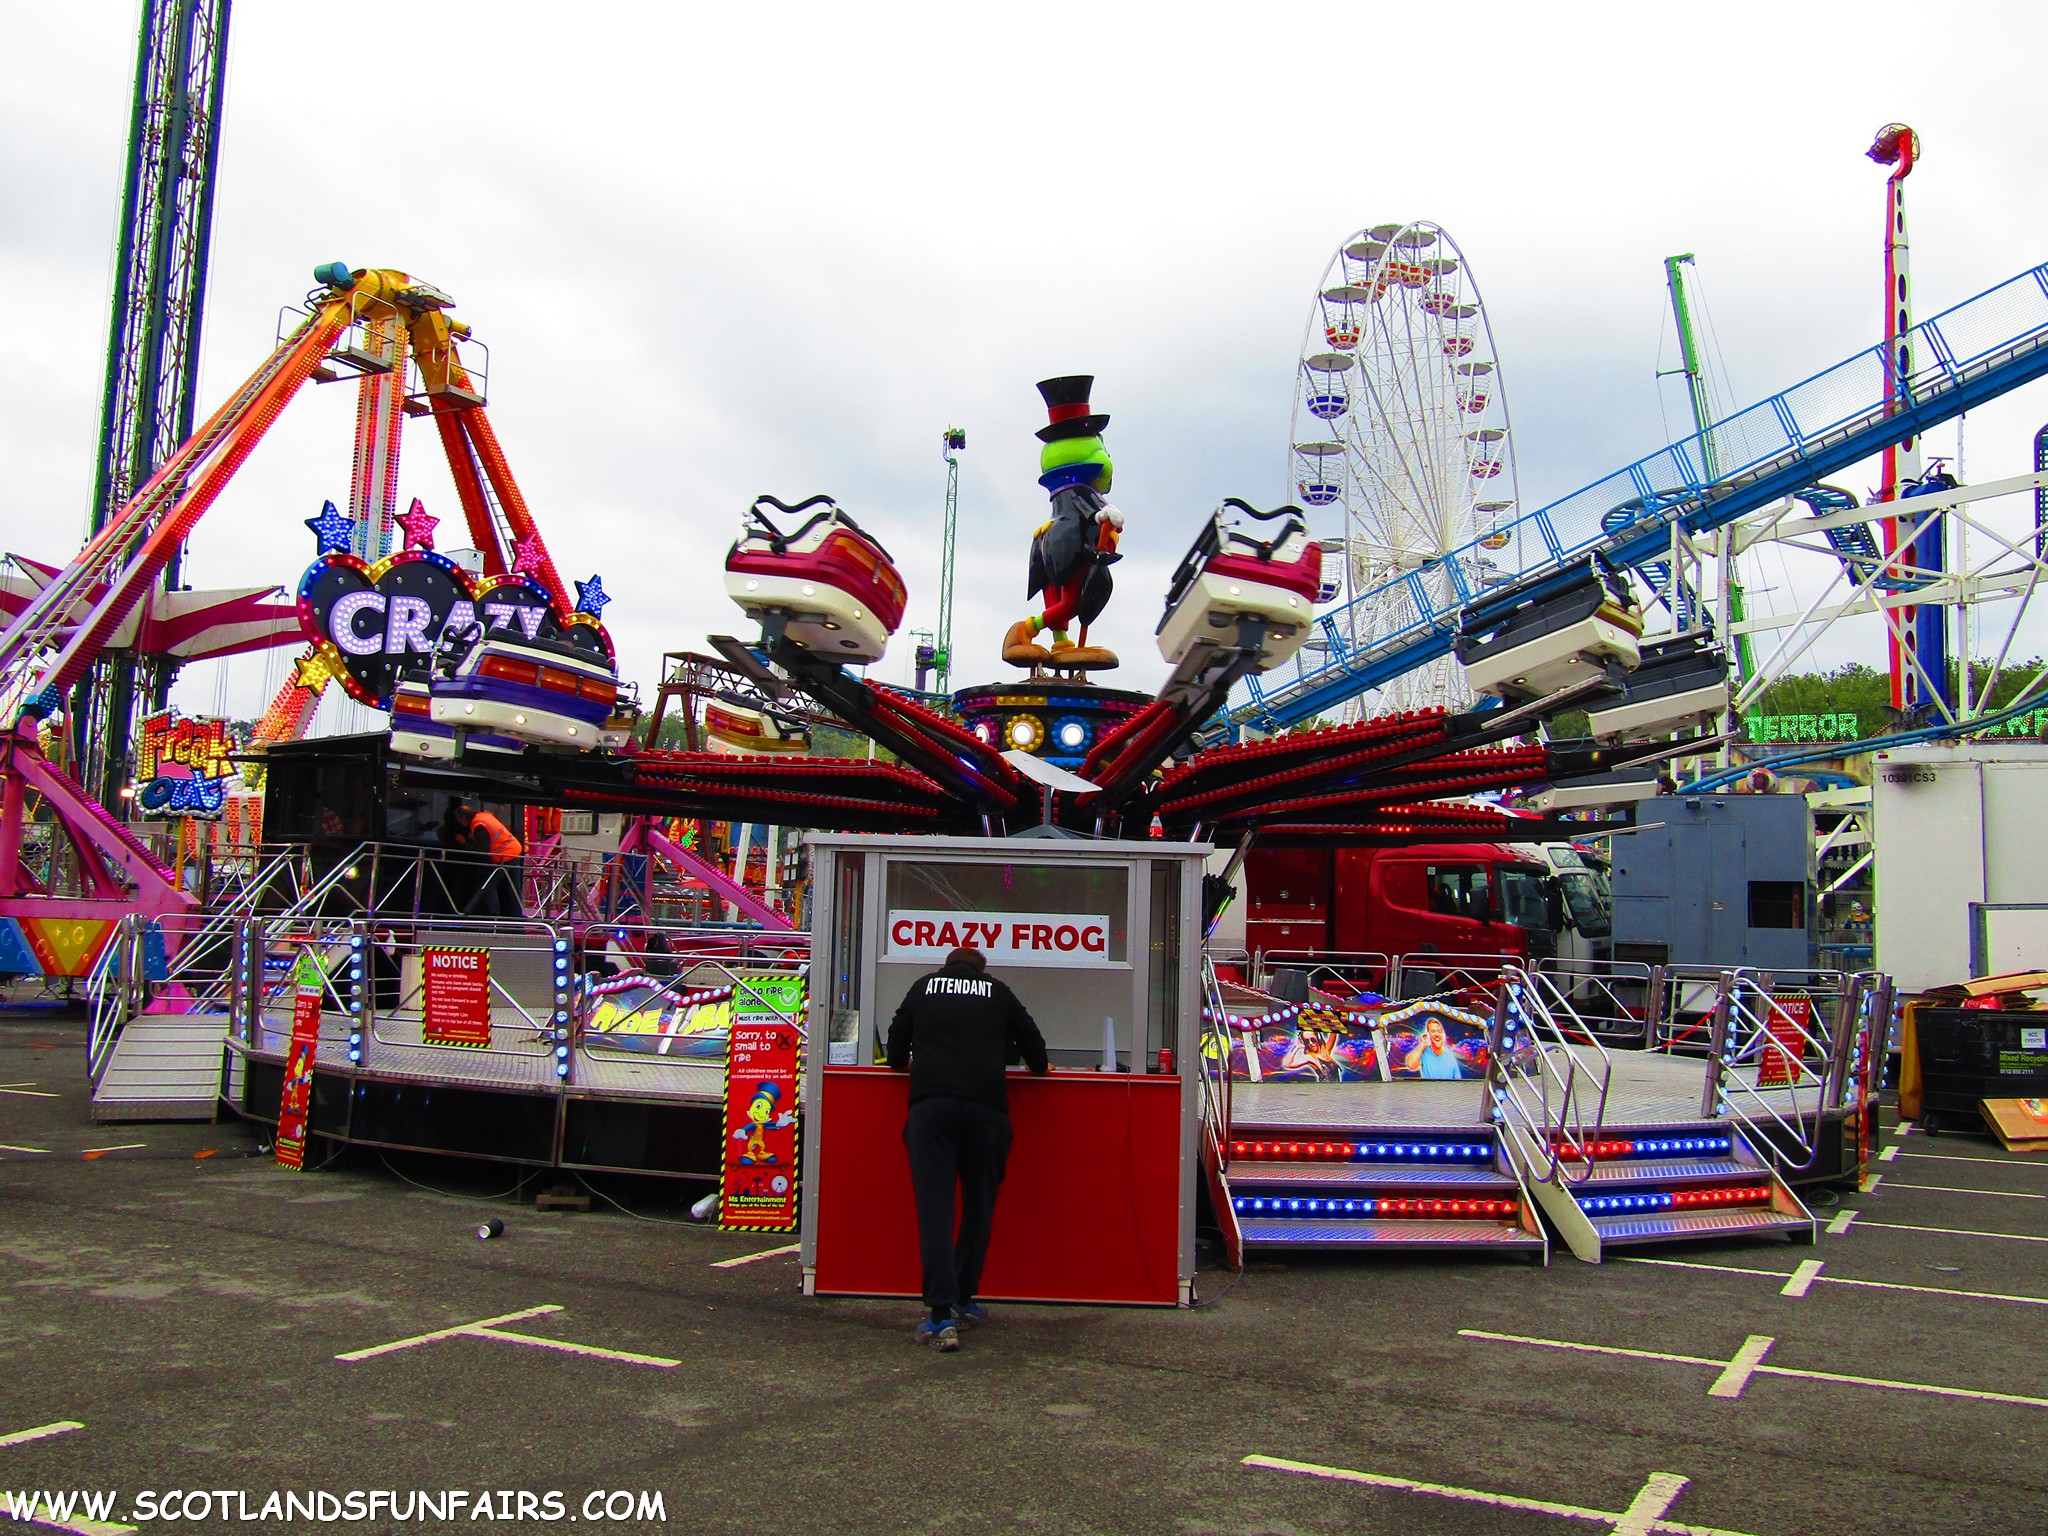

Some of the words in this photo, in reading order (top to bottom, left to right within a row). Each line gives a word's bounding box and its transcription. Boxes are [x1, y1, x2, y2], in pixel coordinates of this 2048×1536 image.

[1743, 713, 1858, 742] TERROR
[891, 920, 1002, 949] CRAZY
[1011, 923, 1105, 952] FROG
[432, 954, 478, 970] NOTICE
[925, 977, 993, 998] ATTENDANT
[589, 1001, 662, 1034] RIDE
[765, 1030, 777, 1039] to
[734, 1041, 757, 1050] small
[760, 1041, 771, 1051] to
[733, 1053, 752, 1062] ride
